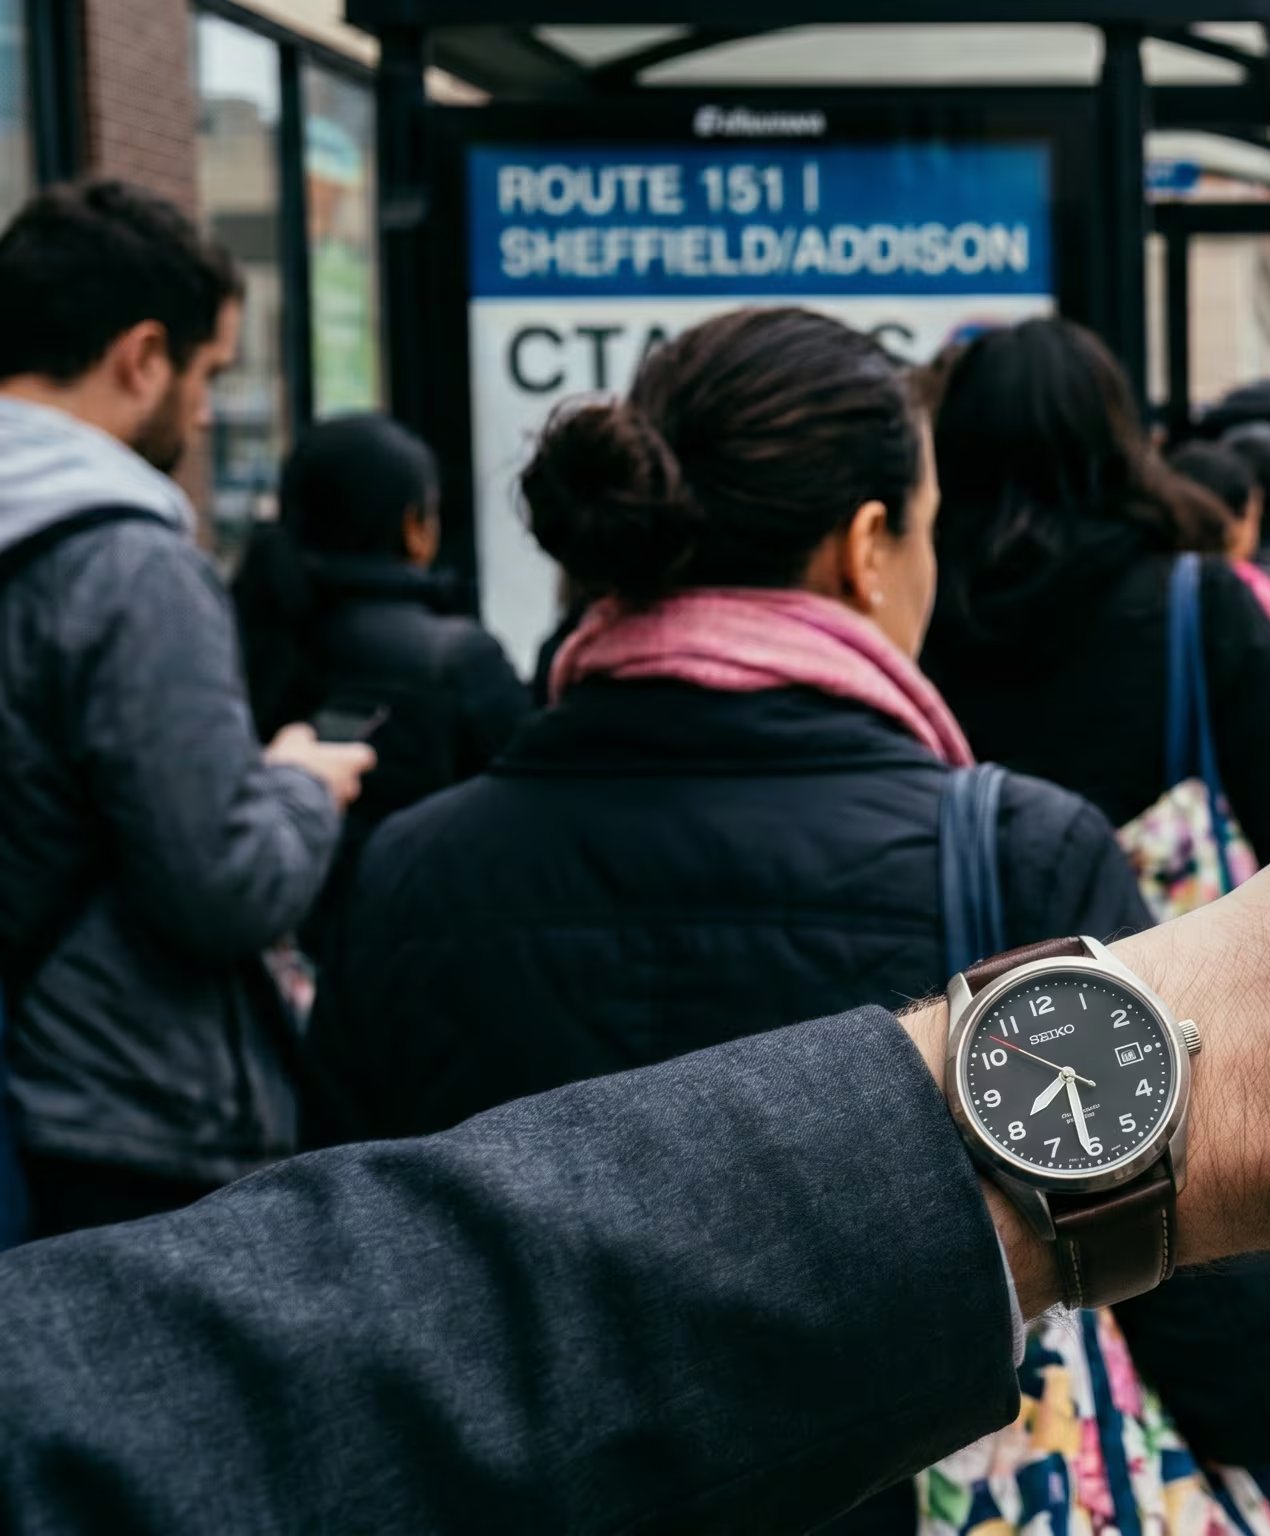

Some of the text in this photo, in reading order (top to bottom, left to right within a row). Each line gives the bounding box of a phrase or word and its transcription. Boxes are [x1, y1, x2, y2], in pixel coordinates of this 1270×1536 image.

[499, 166, 681, 215] ROUTE
[701, 165, 782, 214] 151
[500, 224, 1029, 277] SHEFFIELD/ADDISON
[1029, 996, 1055, 1017] 12
[1079, 992, 1088, 1010] 1
[999, 1015, 1020, 1037] 11
[1110, 1009, 1130, 1029] 2
[1029, 1023, 1075, 1046] SEIKO
[981, 1048, 1008, 1070] 10
[983, 1088, 1002, 1108] 9
[1134, 1078, 1153, 1097] 4
[1007, 1120, 1027, 1141] 8
[1118, 1112, 1137, 1133] 5
[1043, 1136, 1061, 1159] 7
[1087, 1136, 1104, 1157] 6
